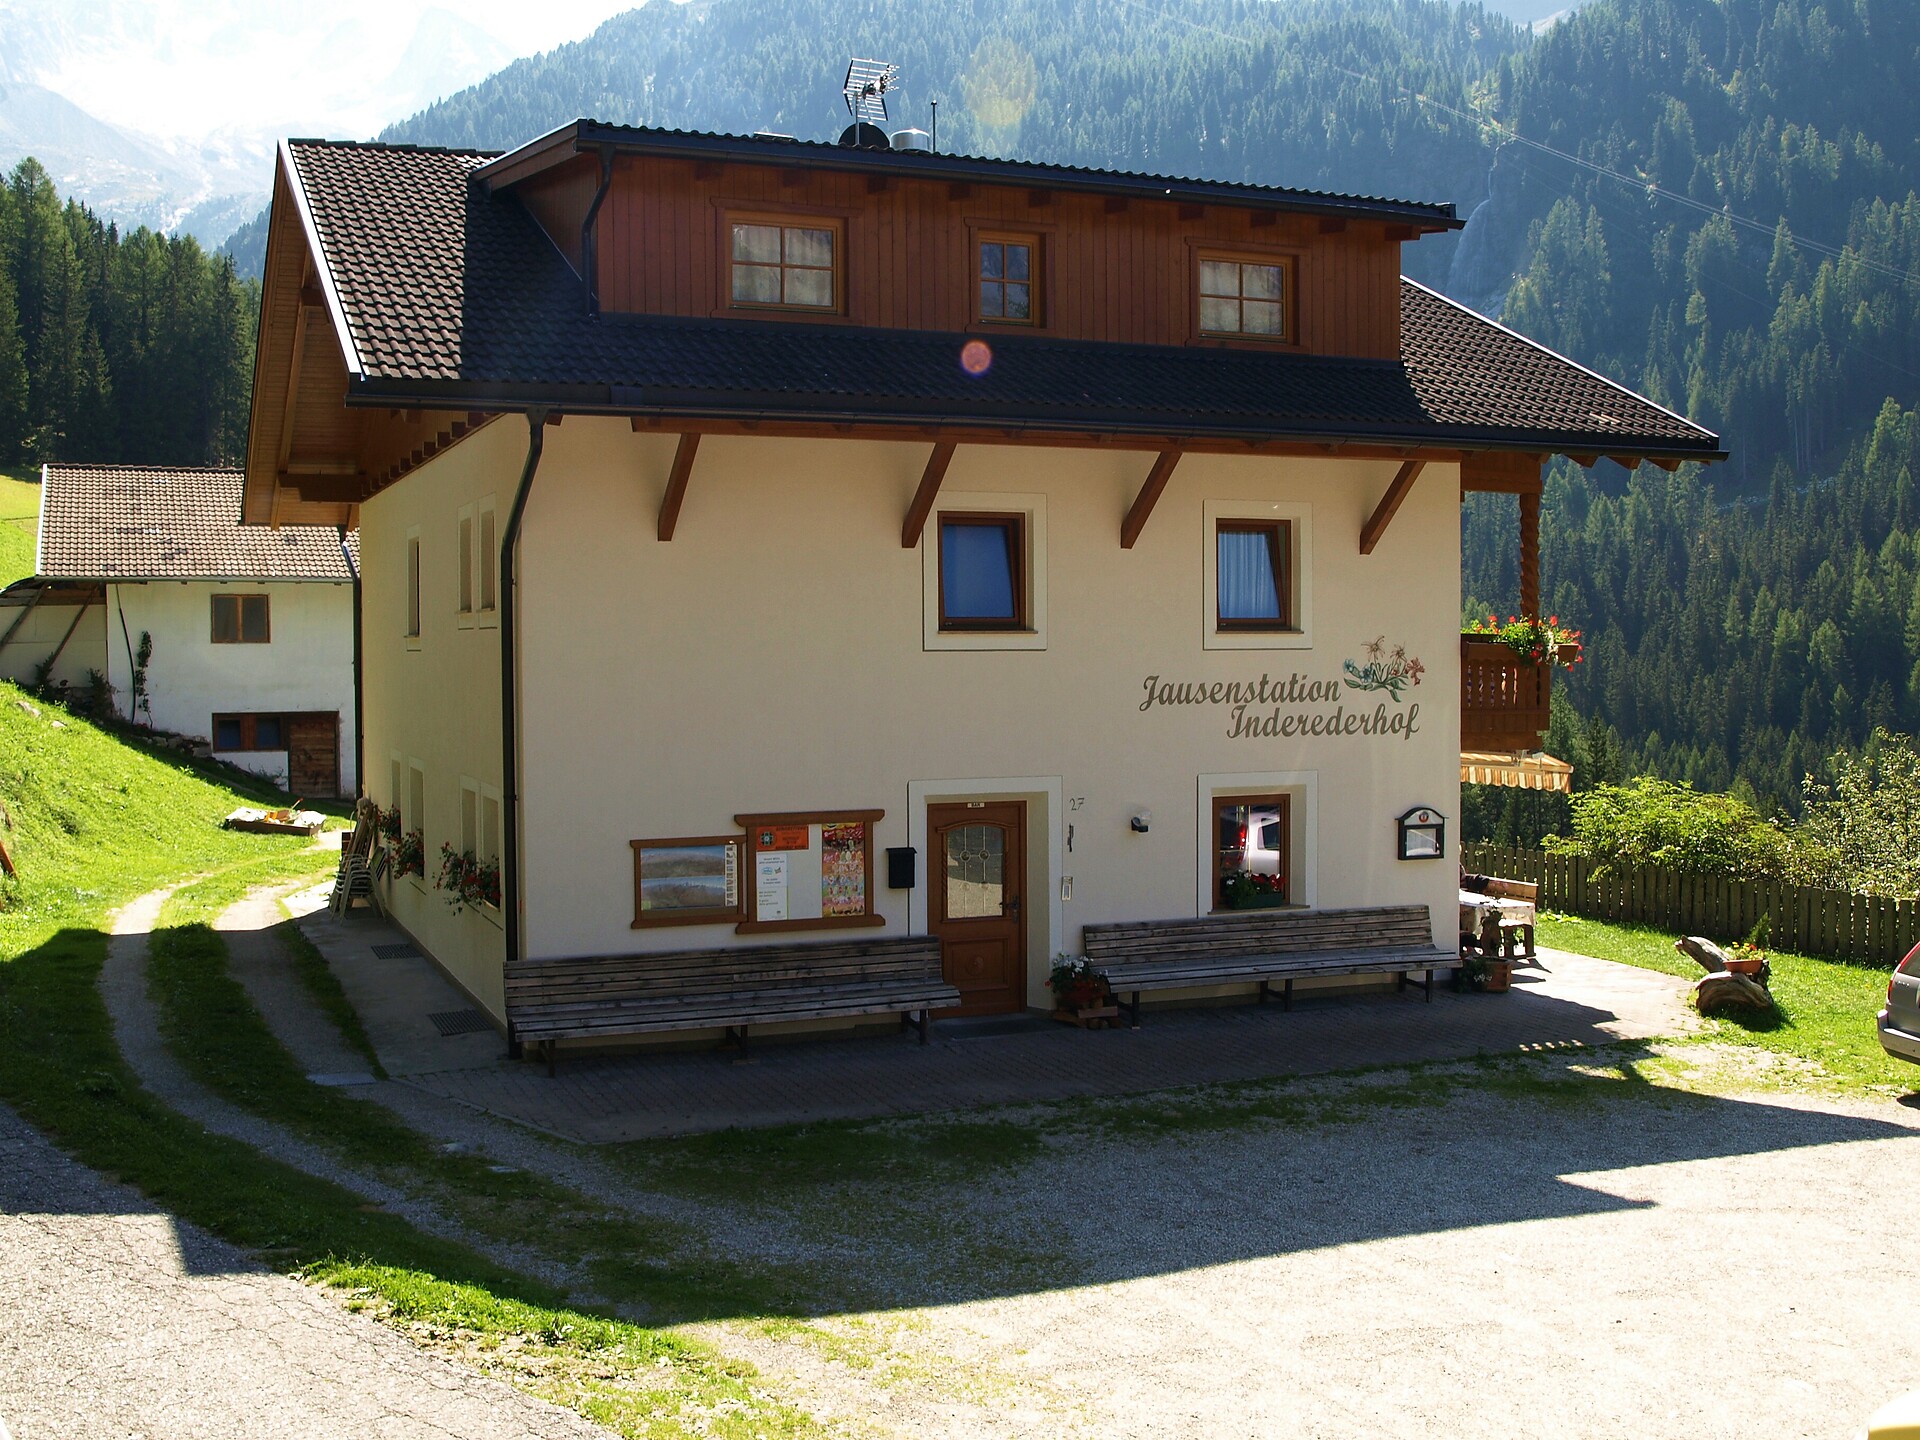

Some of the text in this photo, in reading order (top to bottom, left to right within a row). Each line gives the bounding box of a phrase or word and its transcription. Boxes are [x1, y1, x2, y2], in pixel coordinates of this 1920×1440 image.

[1139, 672, 1341, 712] Jausenstation
[1226, 703, 1420, 740] Inderederhof
[1069, 797, 1085, 811] 27
